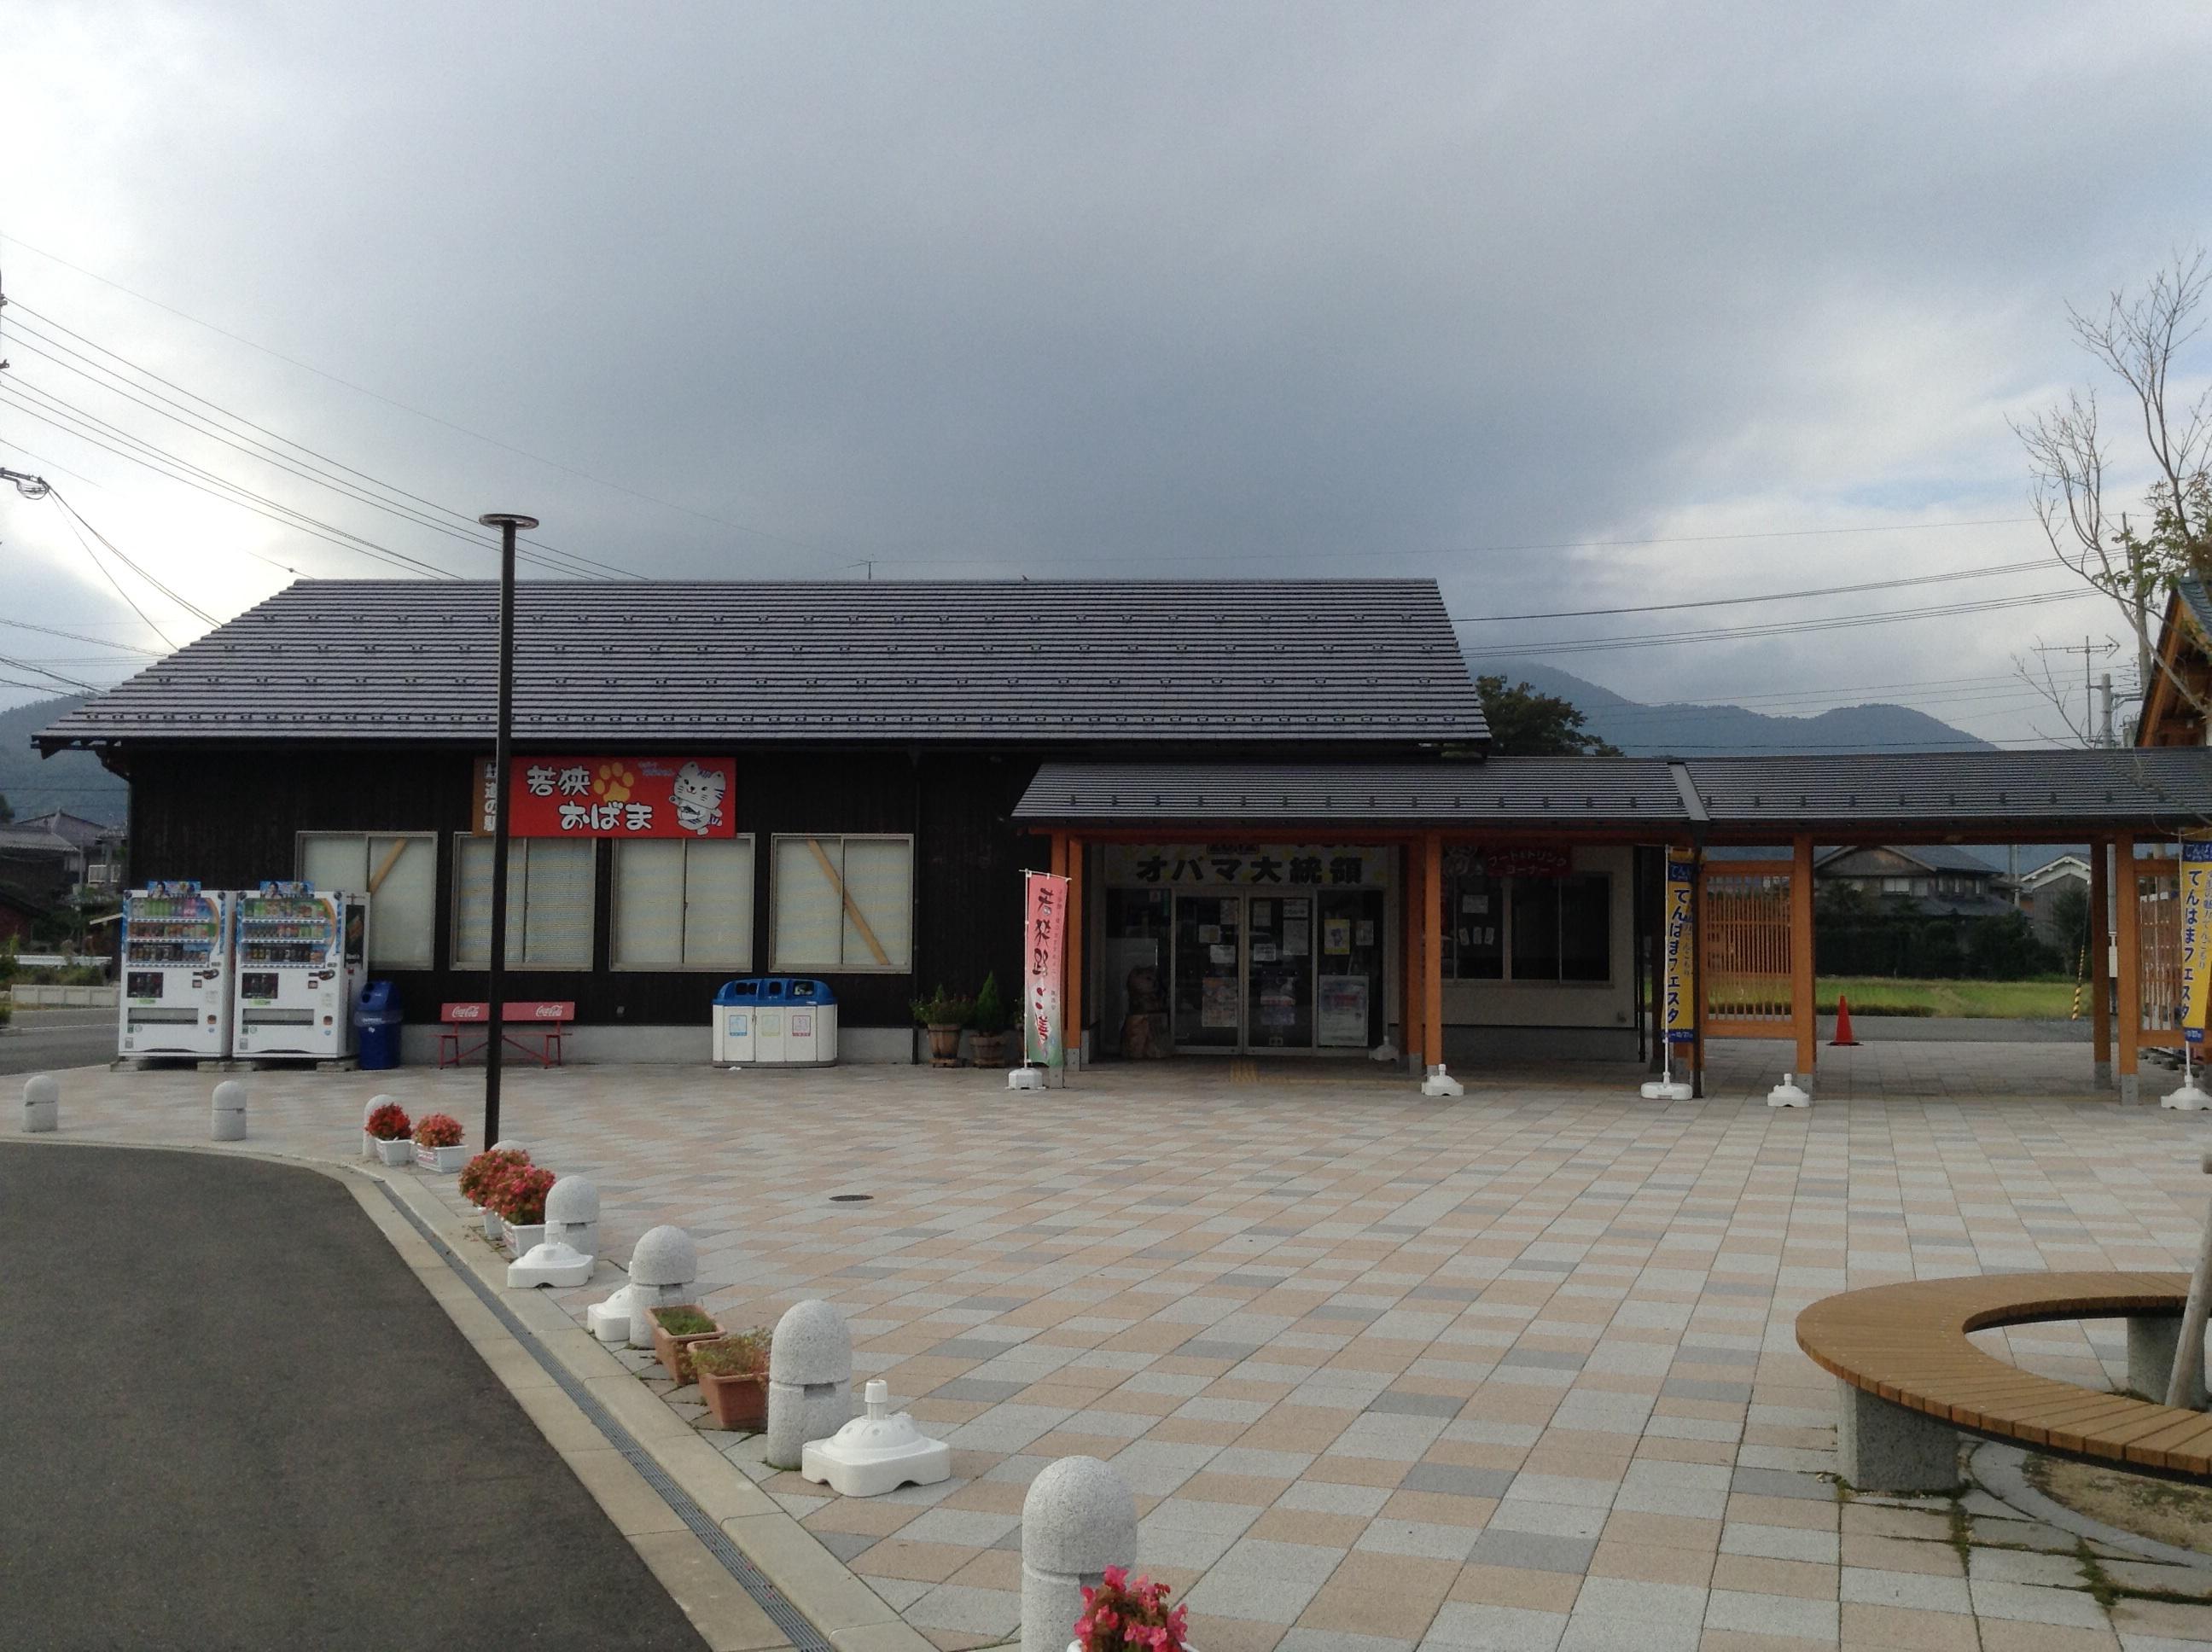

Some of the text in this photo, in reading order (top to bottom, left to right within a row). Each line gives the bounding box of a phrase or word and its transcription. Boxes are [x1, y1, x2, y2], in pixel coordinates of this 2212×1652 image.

[527, 765, 591, 796] 若狭
[558, 800, 653, 830] おばま
[1136, 855, 1363, 884] オバマ大統領
[1505, 864, 1551, 875] コーナー
